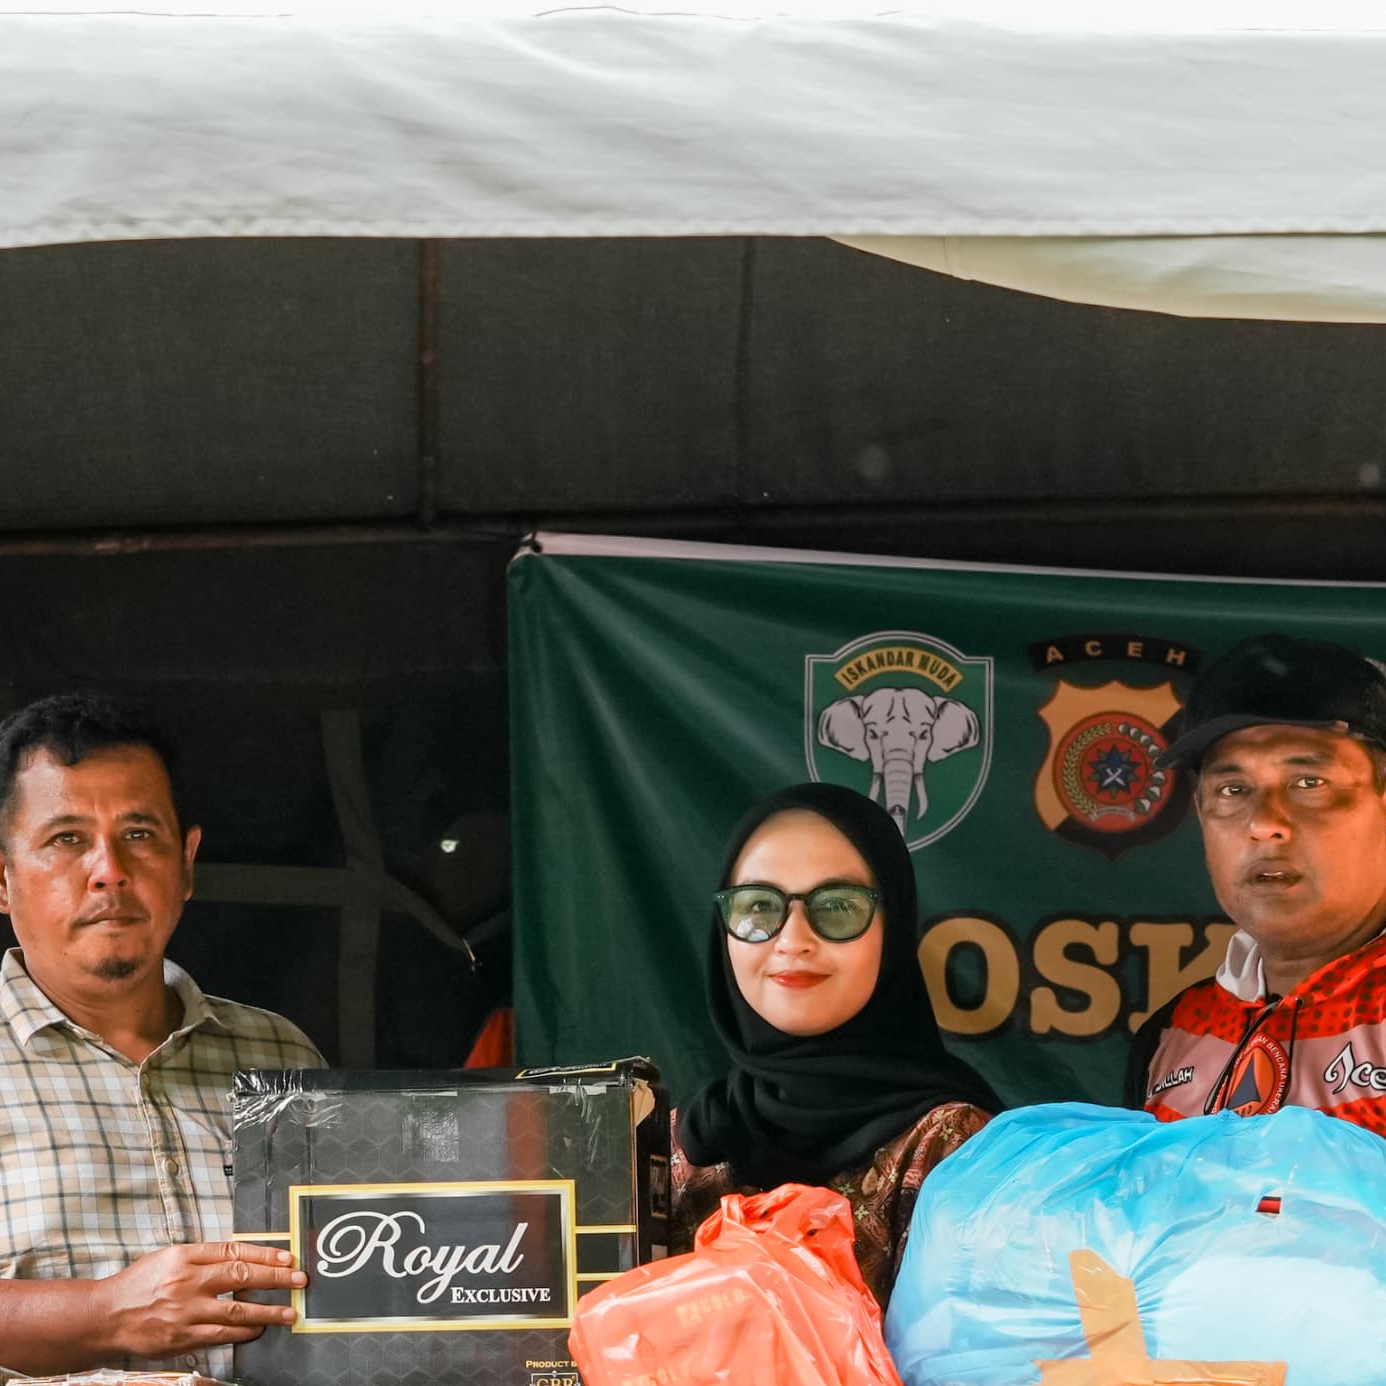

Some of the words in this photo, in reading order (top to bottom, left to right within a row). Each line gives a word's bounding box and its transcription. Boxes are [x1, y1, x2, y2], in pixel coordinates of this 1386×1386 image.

[842, 651, 914, 686] ISKANDAR
[920, 654, 954, 687] MUDA
[1045, 640, 1187, 665] ACEH
[317, 1210, 528, 1304] Royal
